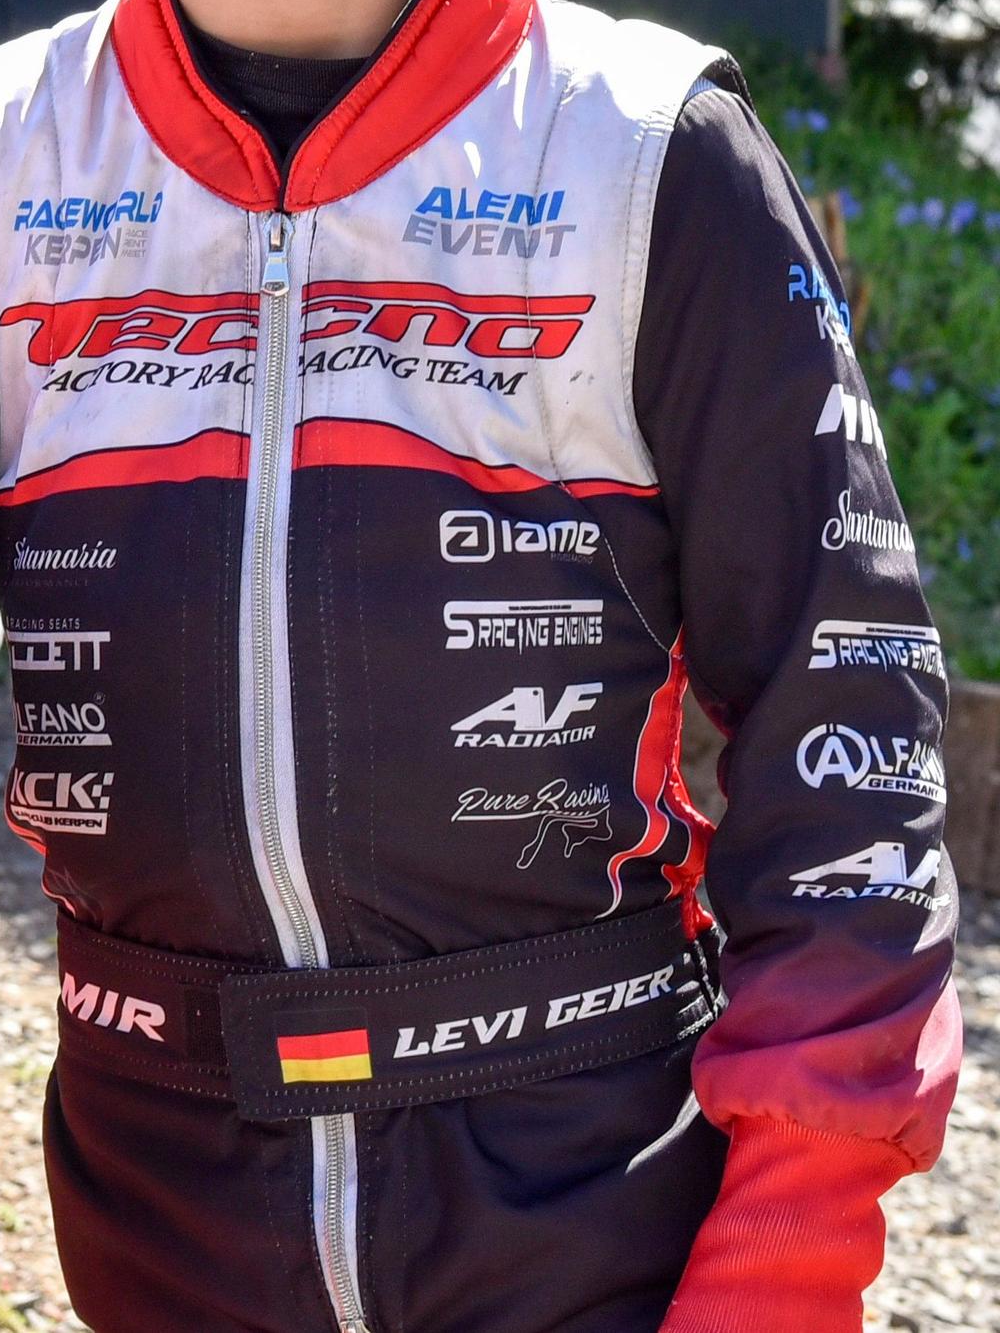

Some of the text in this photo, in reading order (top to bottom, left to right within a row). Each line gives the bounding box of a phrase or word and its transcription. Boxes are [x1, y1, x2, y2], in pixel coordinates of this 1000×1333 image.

[415, 186, 566, 226] ALENI
[402, 214, 577, 258] EVENT
[425, 358, 528, 395] TEAM
[48, 618, 81, 630] SEATS
[554, 615, 603, 647] ENGINES
[14, 702, 106, 733] LFANO
[450, 682, 603, 731] AF
[17, 735, 86, 745] GERMANY
[454, 726, 597, 748] RADIATOR
[452, 788, 531, 822] Pure
[54, 816, 103, 828] KERPEN
[791, 883, 951, 912] RADIATOR
[61, 971, 166, 1043] MIR
[393, 965, 675, 1058] LEVI GEIER
